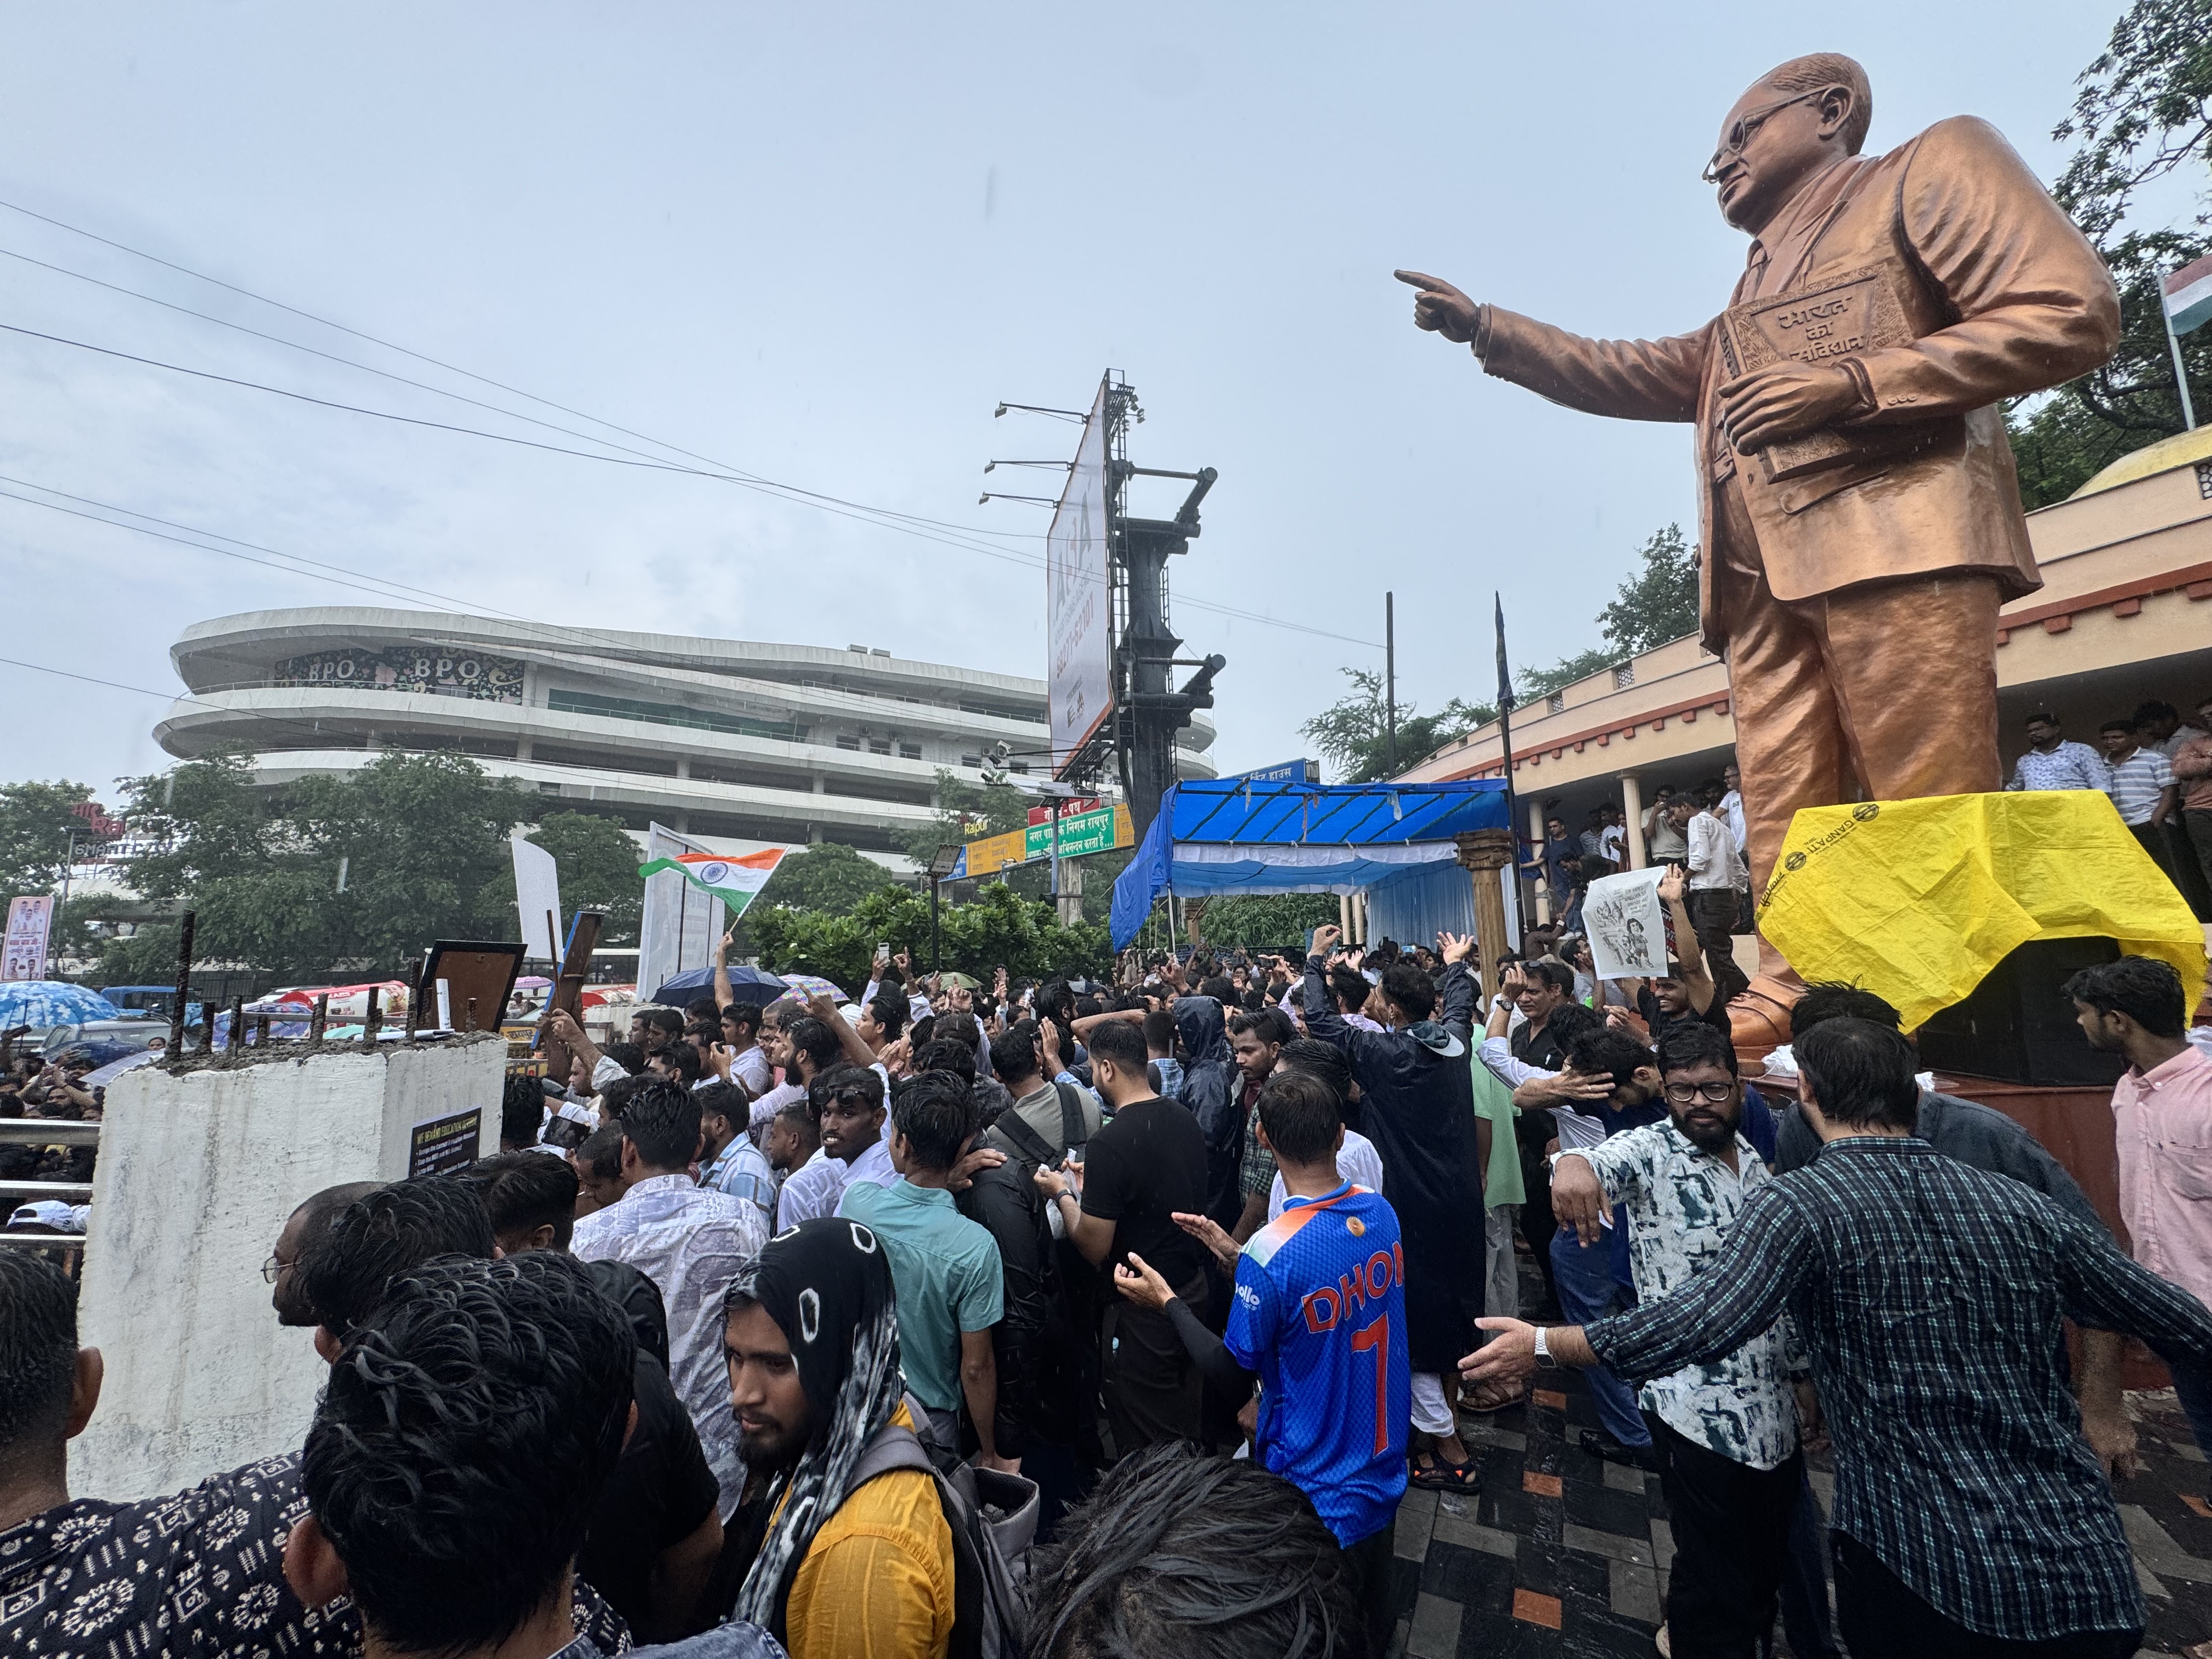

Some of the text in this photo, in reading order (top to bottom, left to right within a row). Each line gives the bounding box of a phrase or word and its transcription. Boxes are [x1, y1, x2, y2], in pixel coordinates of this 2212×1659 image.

[1805, 320, 1833, 340] का
[309, 659, 356, 680] BPO
[414, 658, 481, 679] BPO
[1029, 830, 1043, 843] नगर
[1066, 819, 1086, 834] निगम
[1087, 814, 1110, 831] रायपुर
[1807, 820, 1855, 854] GANPATI
[1350, 1311, 1390, 1459] 7
